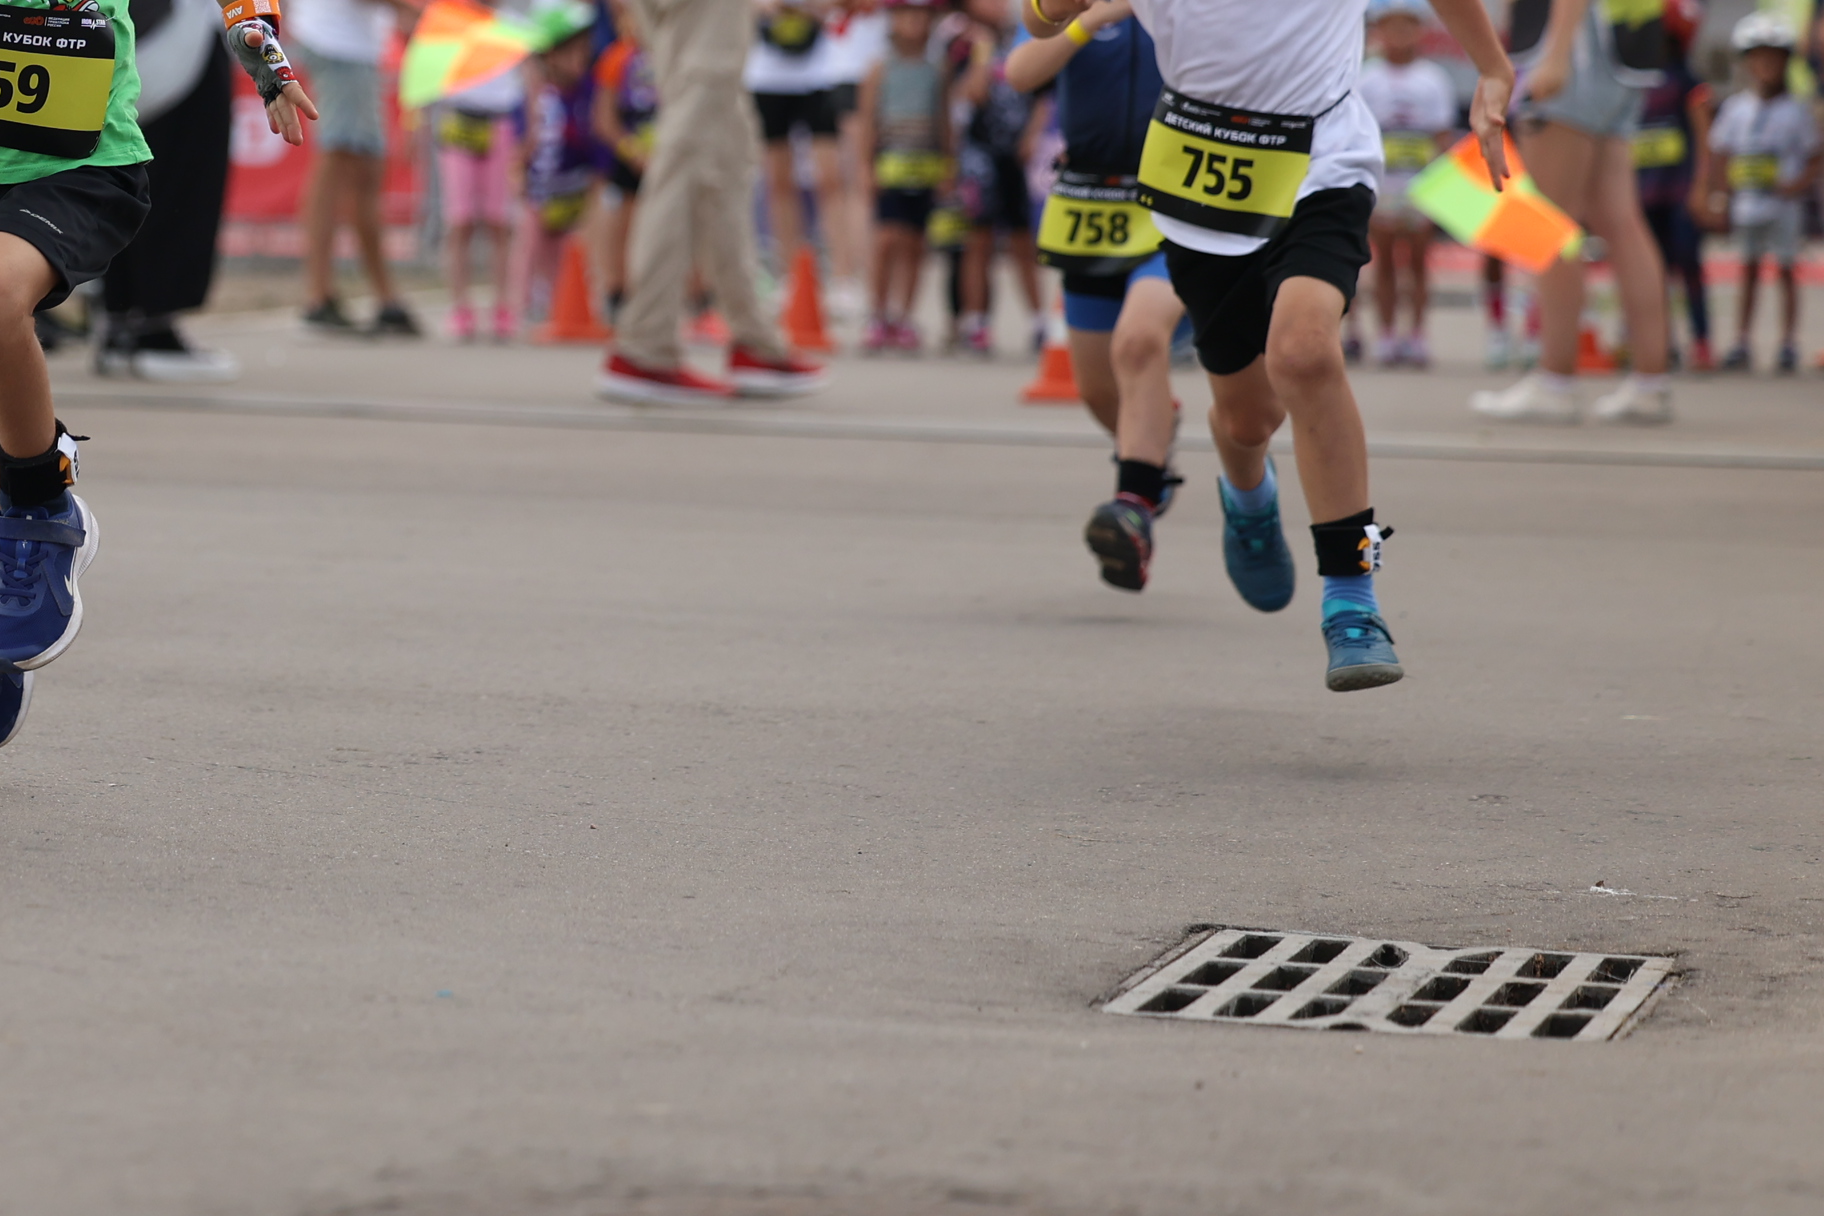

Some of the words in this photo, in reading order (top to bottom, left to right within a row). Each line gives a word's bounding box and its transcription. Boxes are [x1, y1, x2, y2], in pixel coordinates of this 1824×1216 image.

[225, 5, 243, 20] AVA
[2, 32, 53, 48] КУБОК
[55, 37, 87, 50] ФТР
[1164, 110, 1213, 136] ДЕТСКИЙ
[1213, 126, 1257, 145] КУБОК
[1258, 134, 1288, 146] ФТР
[1181, 144, 1255, 202] 755
[1064, 208, 1130, 246] 758
